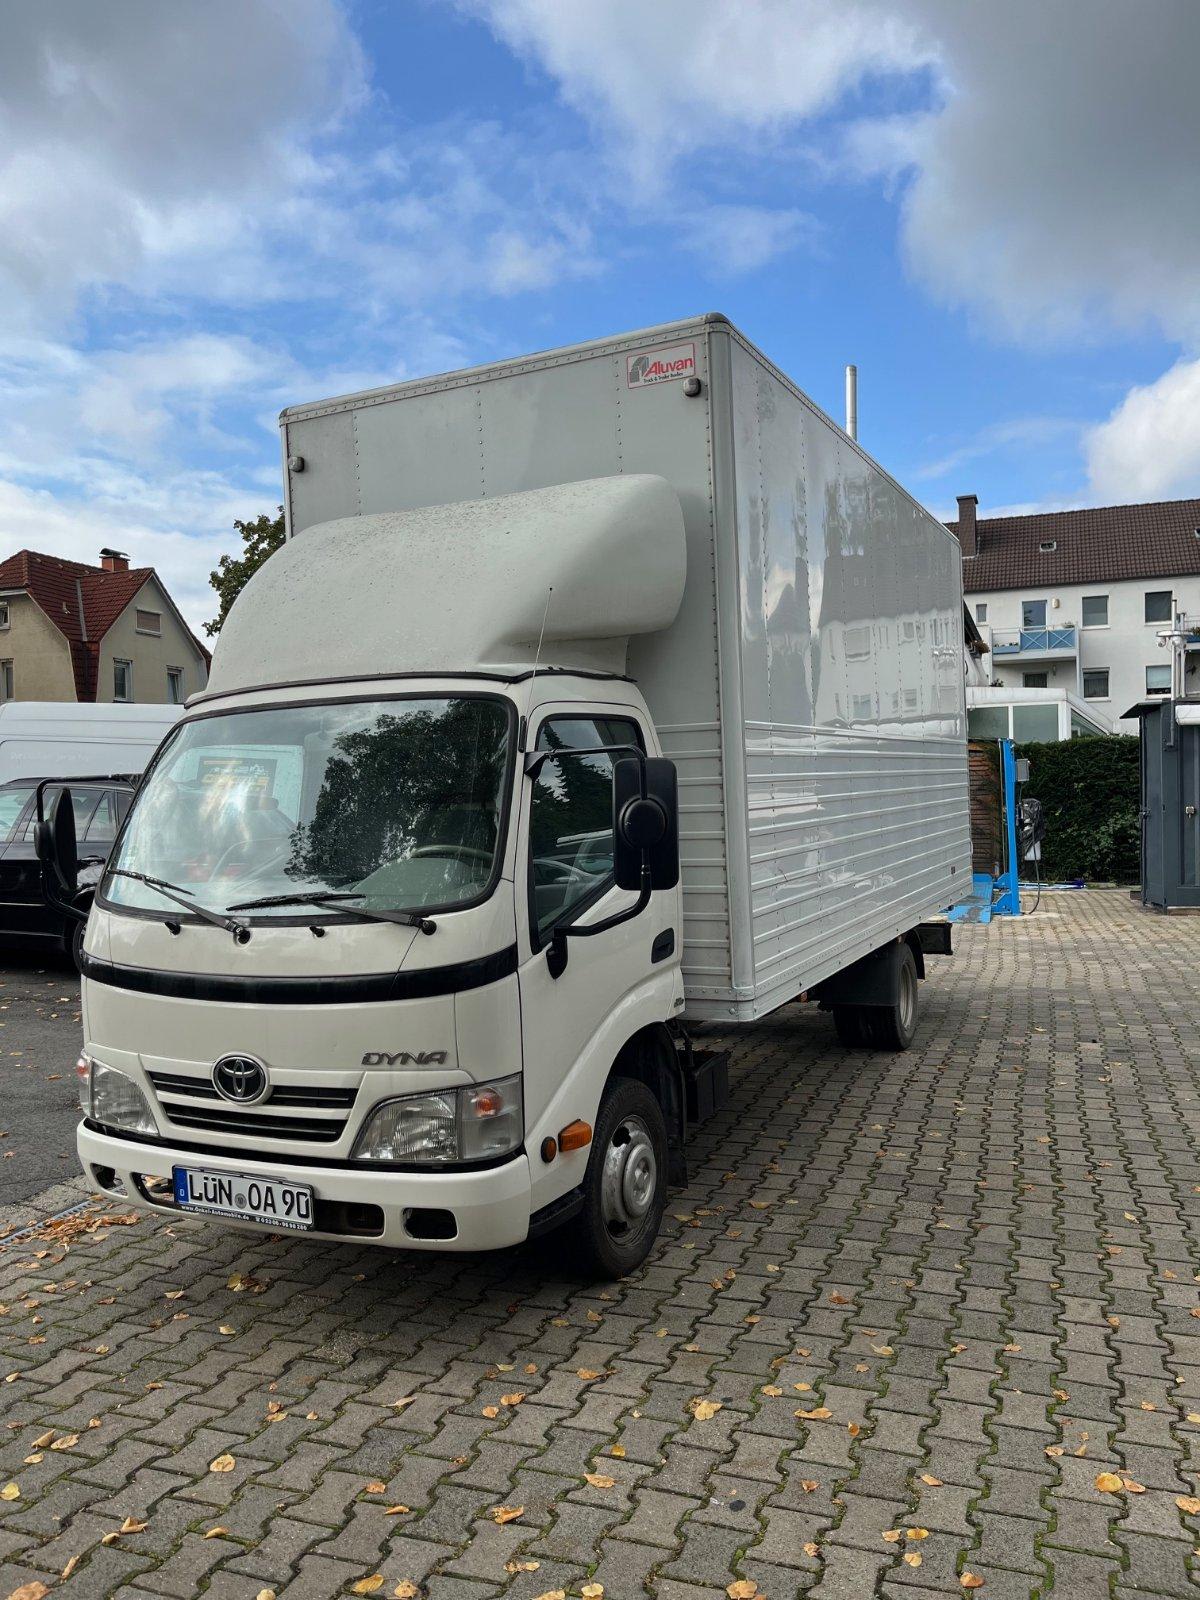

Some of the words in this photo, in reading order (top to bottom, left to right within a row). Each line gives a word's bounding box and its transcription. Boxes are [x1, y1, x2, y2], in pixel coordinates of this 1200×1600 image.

[643, 358, 693, 378] Aluvan
[361, 1051, 447, 1065] DYNA
[248, 1183, 276, 1214] OA
[281, 1189, 310, 1219] 90
